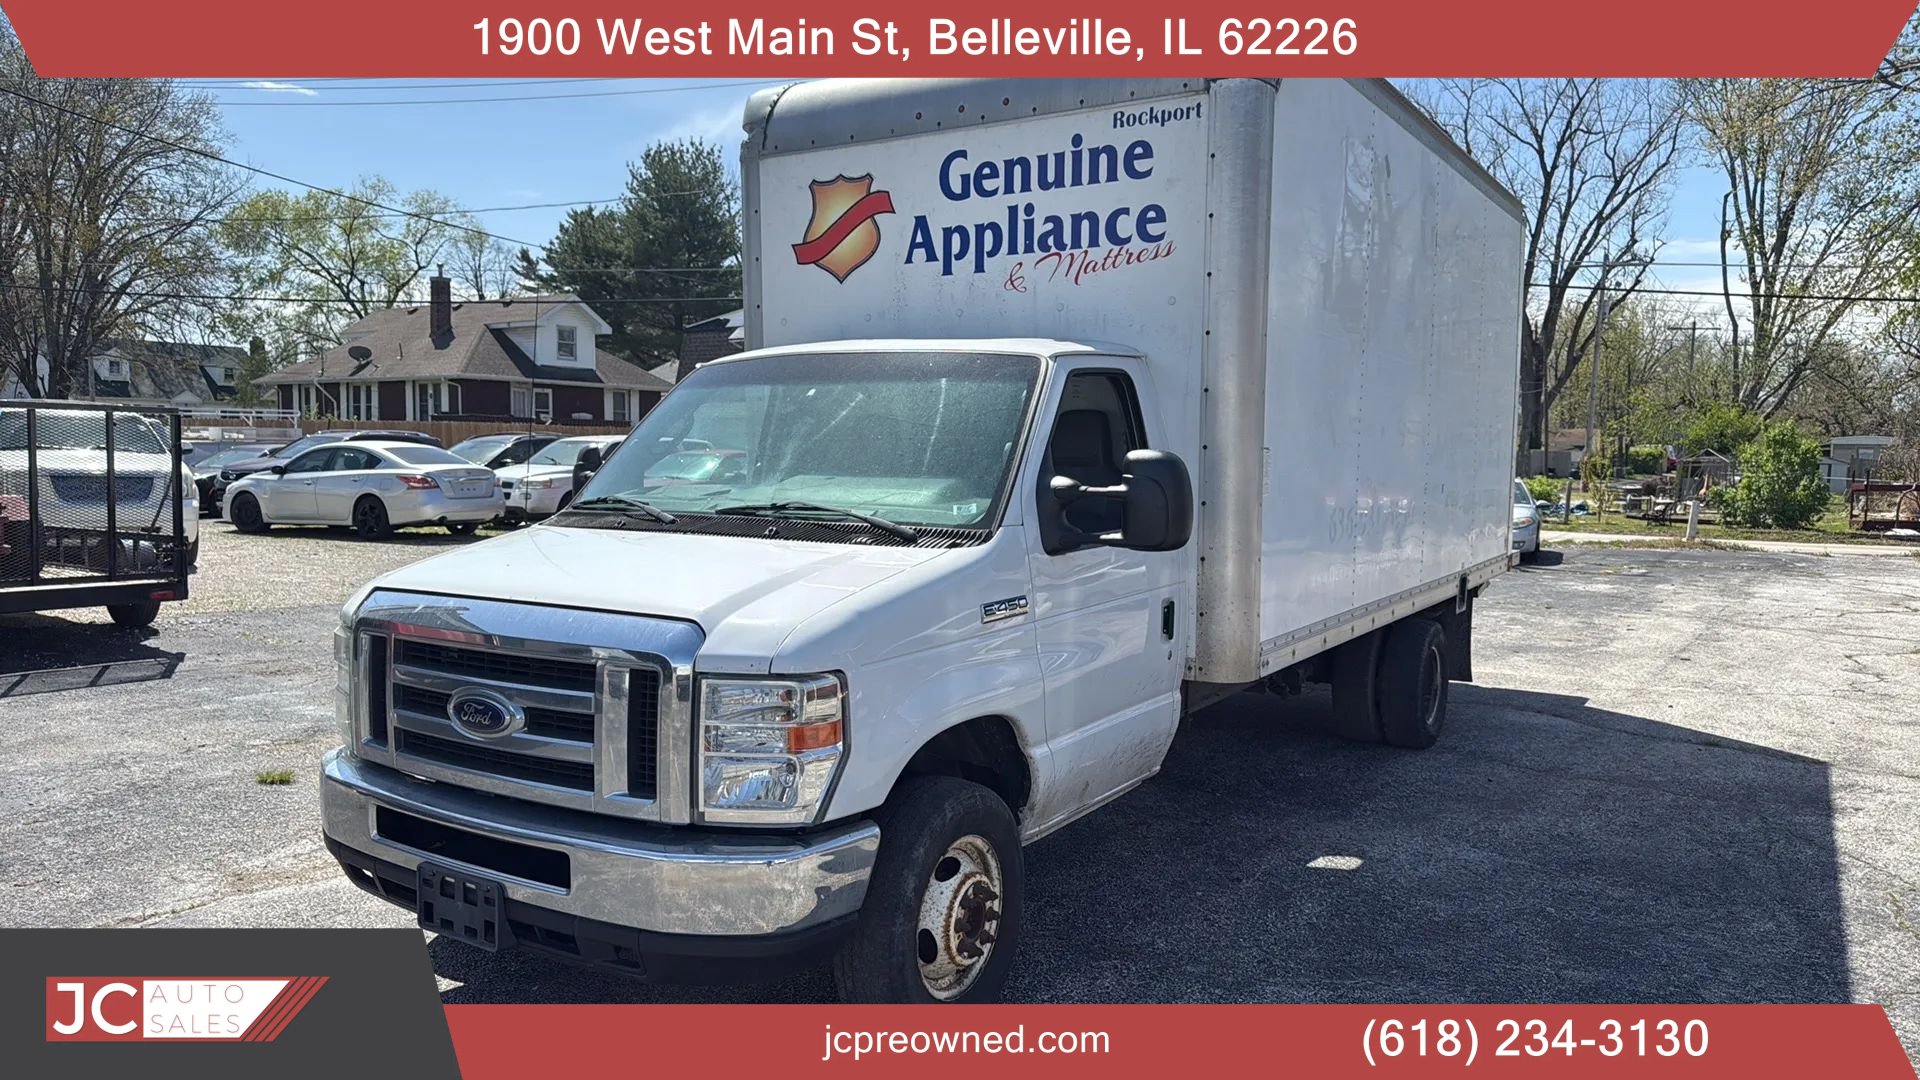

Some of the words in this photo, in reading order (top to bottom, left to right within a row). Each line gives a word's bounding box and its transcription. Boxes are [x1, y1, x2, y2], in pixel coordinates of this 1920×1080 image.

[1113, 102, 1203, 129] Rockport
[939, 133, 1154, 200] Genuine
[904, 202, 1167, 275] Appliance
[1003, 262, 1027, 292] &
[1034, 239, 1176, 285] Mattress
[461, 702, 492, 725] Ford
